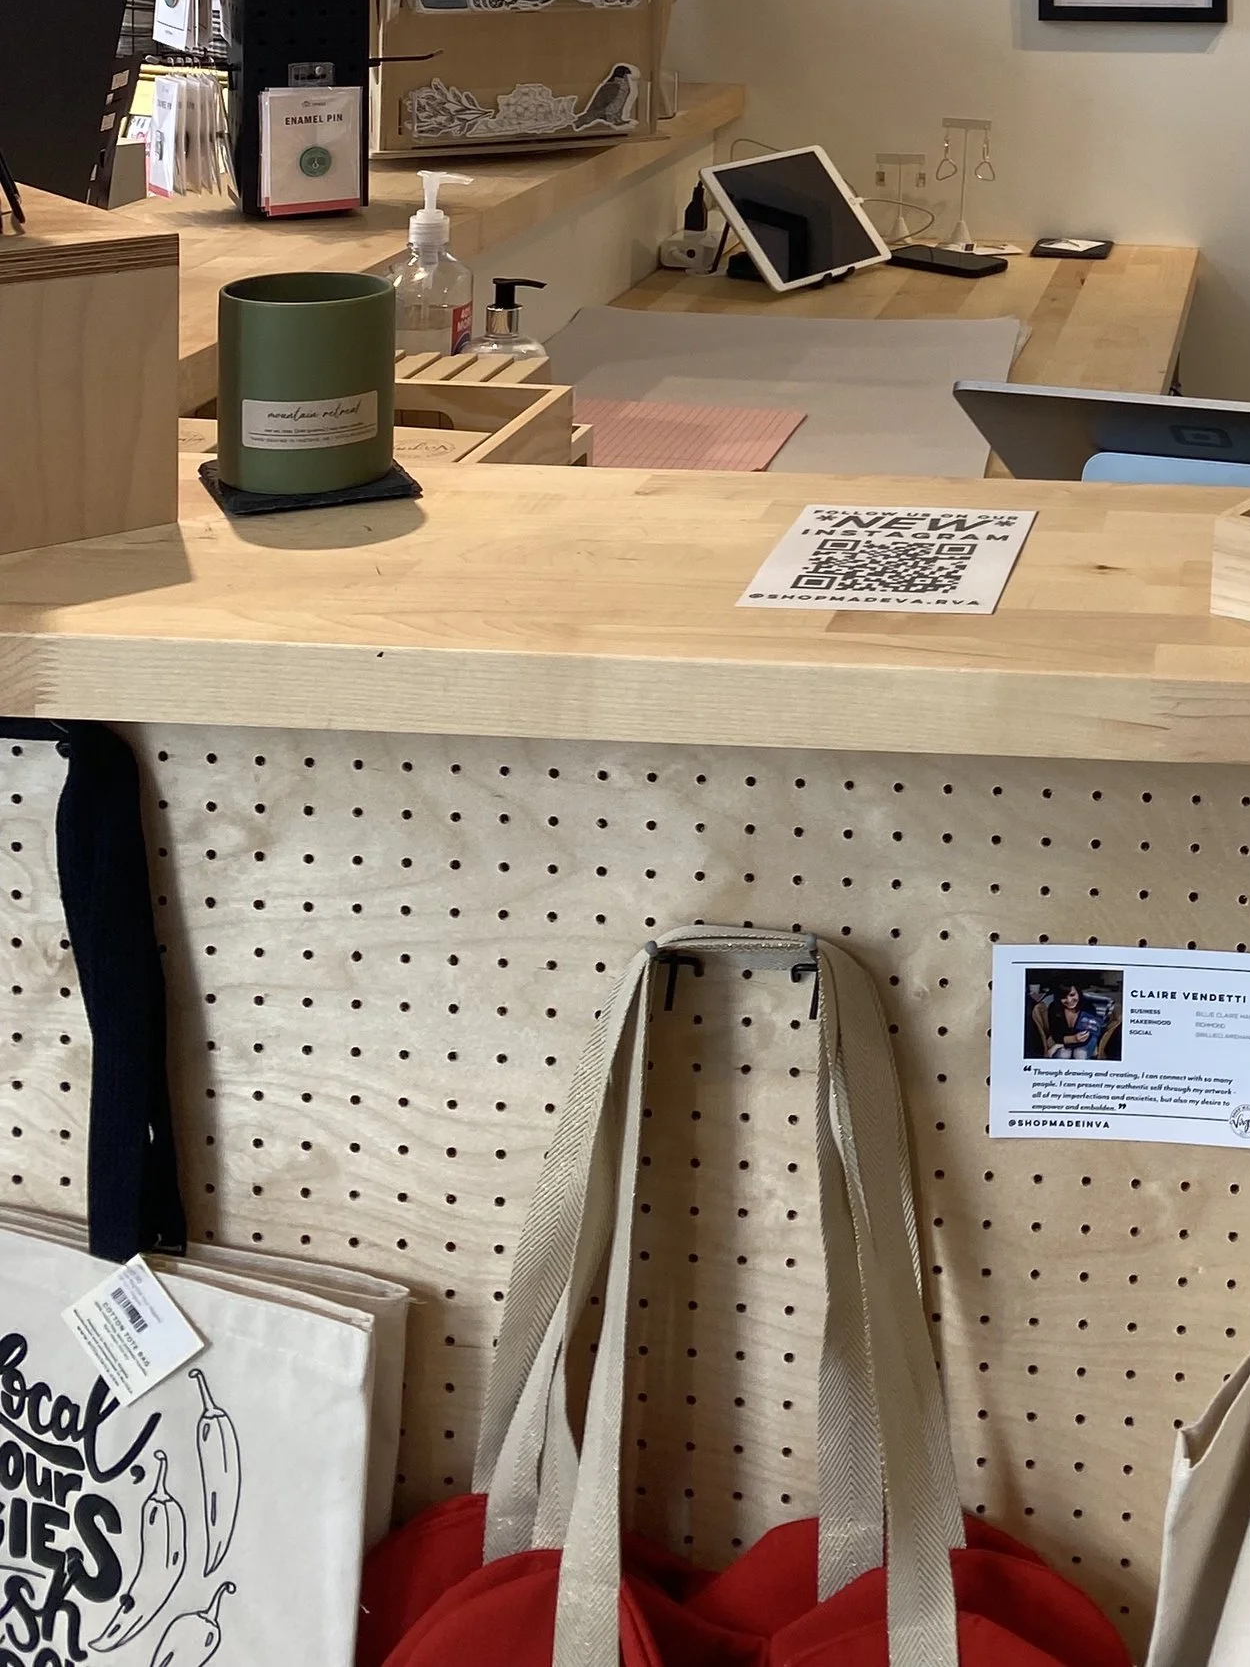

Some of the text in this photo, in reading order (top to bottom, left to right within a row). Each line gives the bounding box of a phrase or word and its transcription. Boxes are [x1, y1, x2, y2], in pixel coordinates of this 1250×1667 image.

[285, 114, 343, 125] ENAMEL PIN
[267, 398, 362, 421] mountain retreat
[813, 509, 898, 517] FOLLOW
[801, 529, 1009, 542] INSTAGRAM
[749, 593, 980, 606] @SHOPMADEVA.RVA
[1130, 990, 1247, 1003] CLAIRE VENDETTI
[1064, 1069, 1094, 1078] drawing
[1109, 1072, 1140, 1080] creating,
[1164, 1085, 1191, 1094] through
[1192, 1087, 1203, 1095] my
[1062, 1092, 1110, 1100] imperfections
[1125, 1095, 1159, 1103] anxieties,
[1008, 1118, 1110, 1130] @SHOPMADEINVA
[102, 1301, 150, 1367] COTTON TOTE BAG
